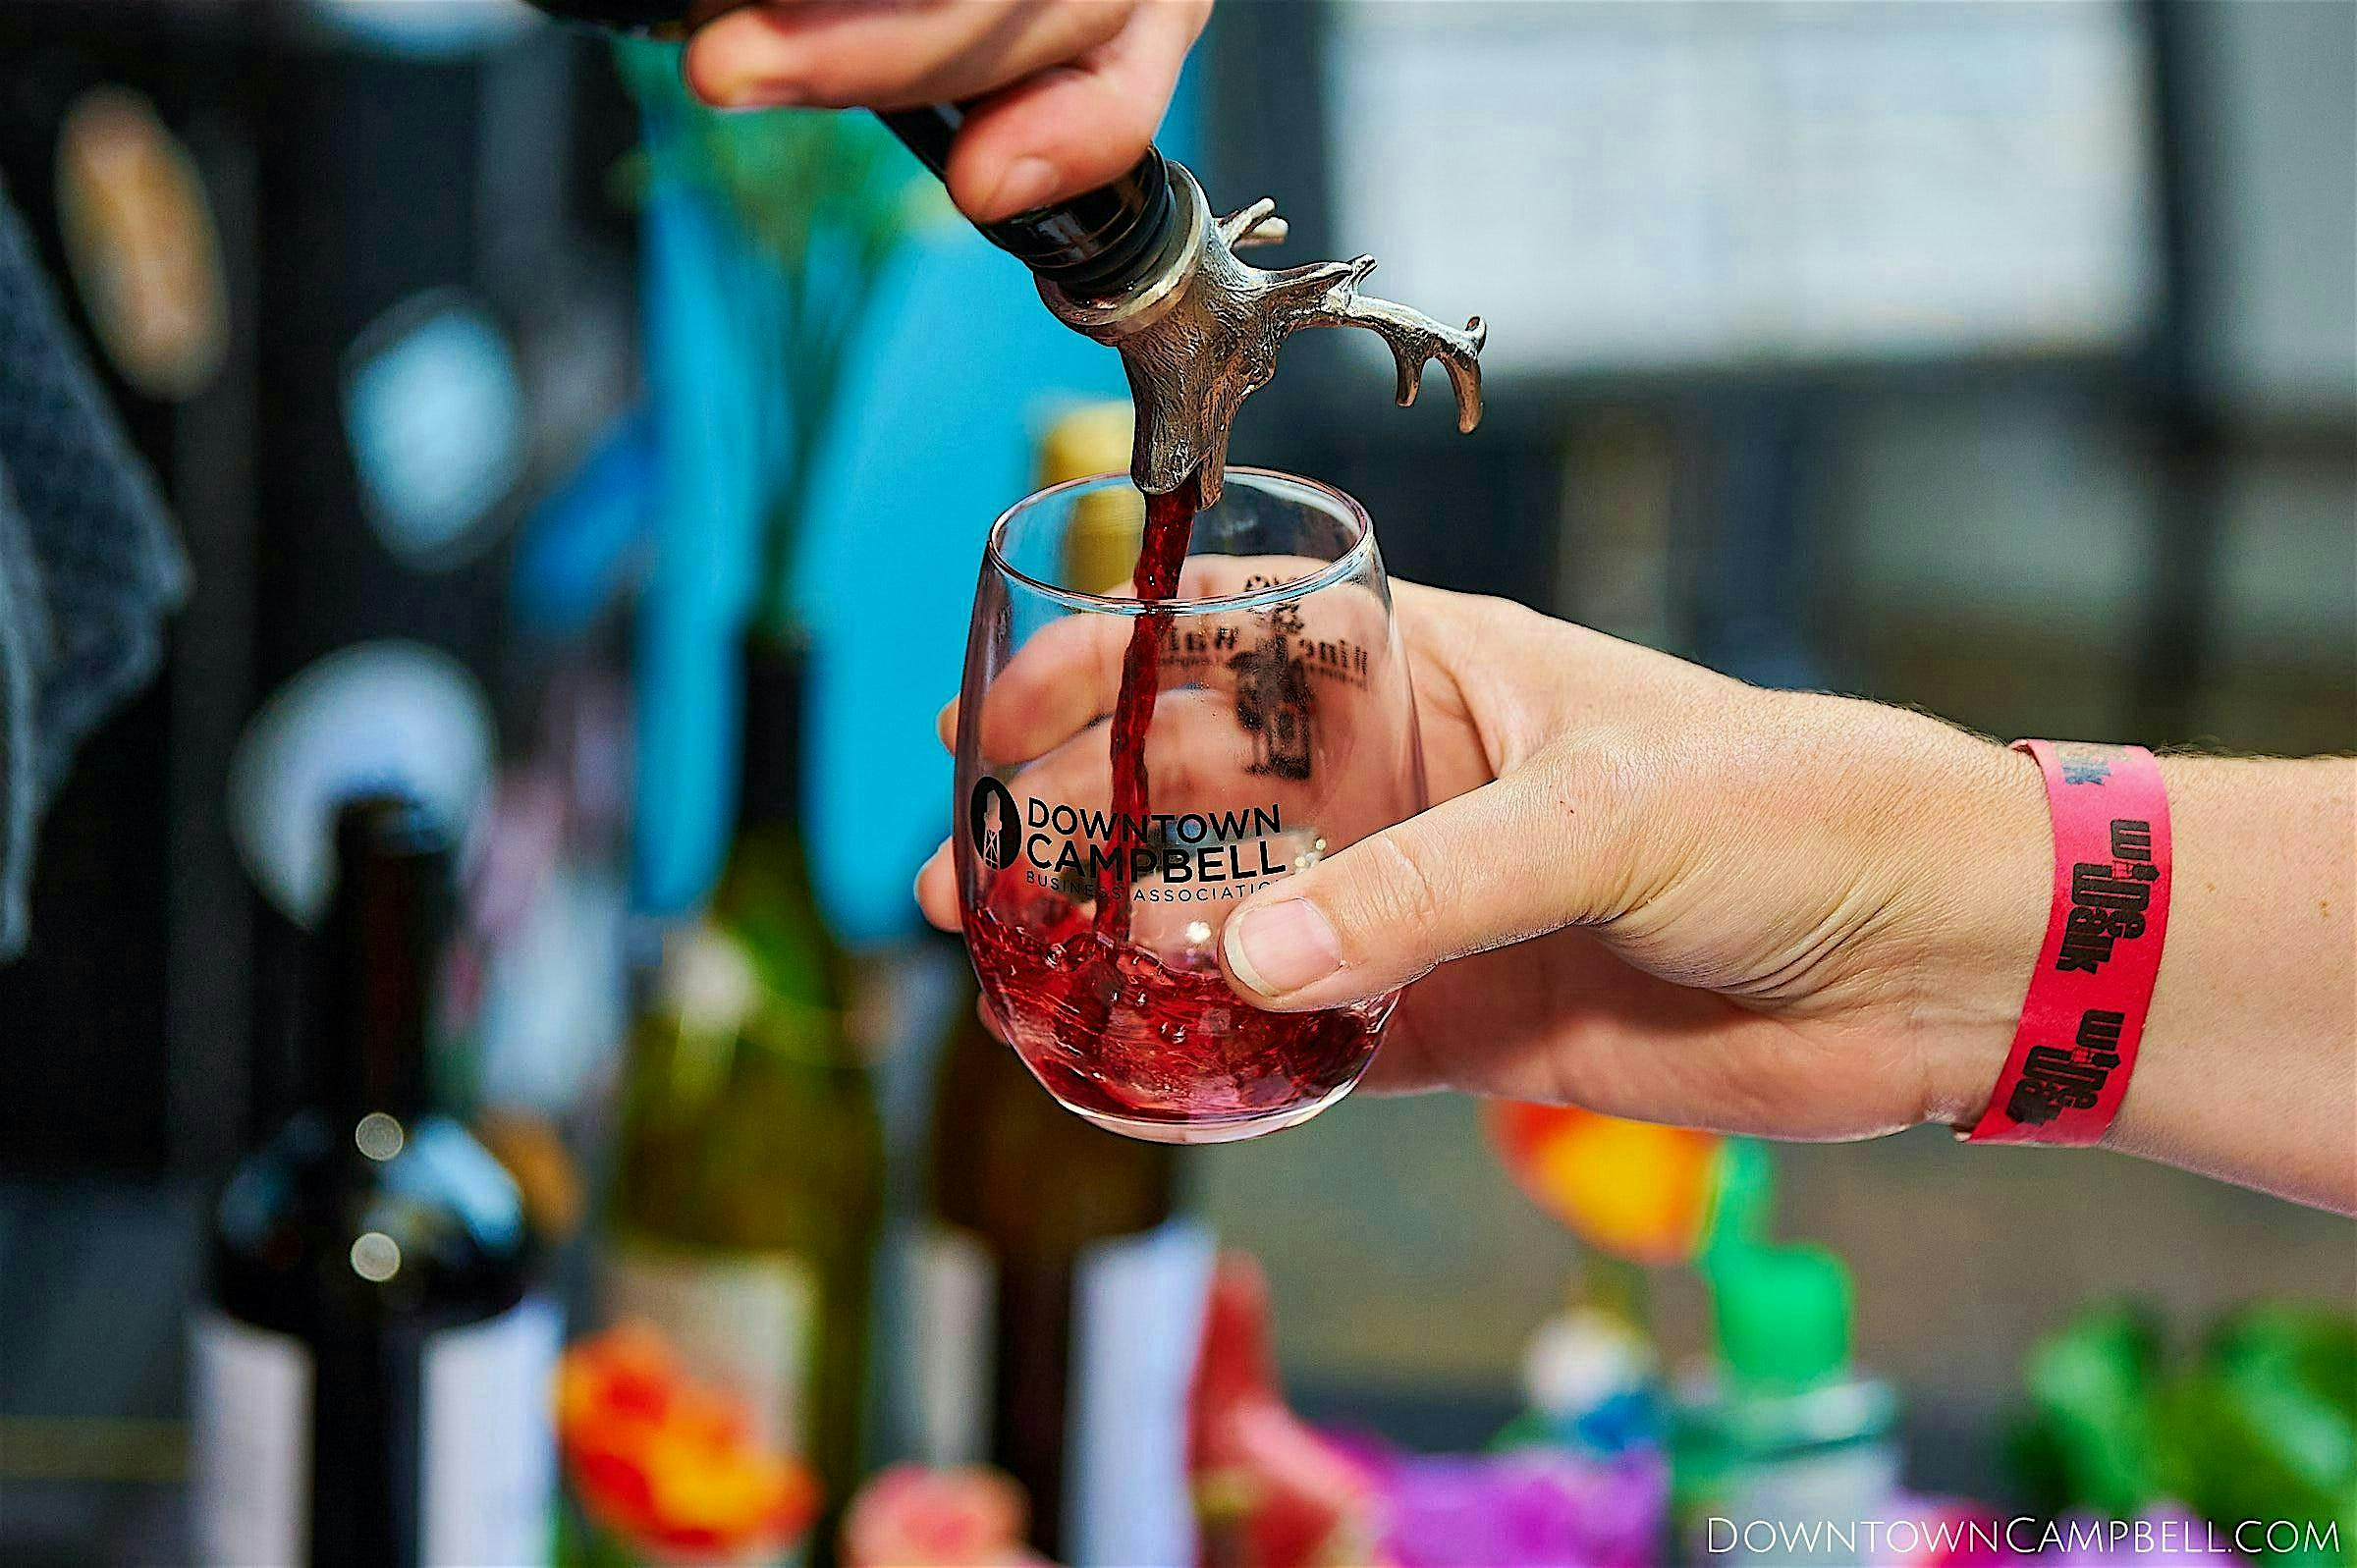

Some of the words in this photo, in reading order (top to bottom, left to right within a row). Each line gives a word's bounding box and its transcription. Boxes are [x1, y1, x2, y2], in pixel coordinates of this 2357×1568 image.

[1027, 796, 1282, 844] DOWNTOWN
[1026, 833, 1287, 884] CAMPBELL
[1026, 870, 1124, 900] BUSINESS
[1132, 879, 1279, 903] ASSOCIATI
